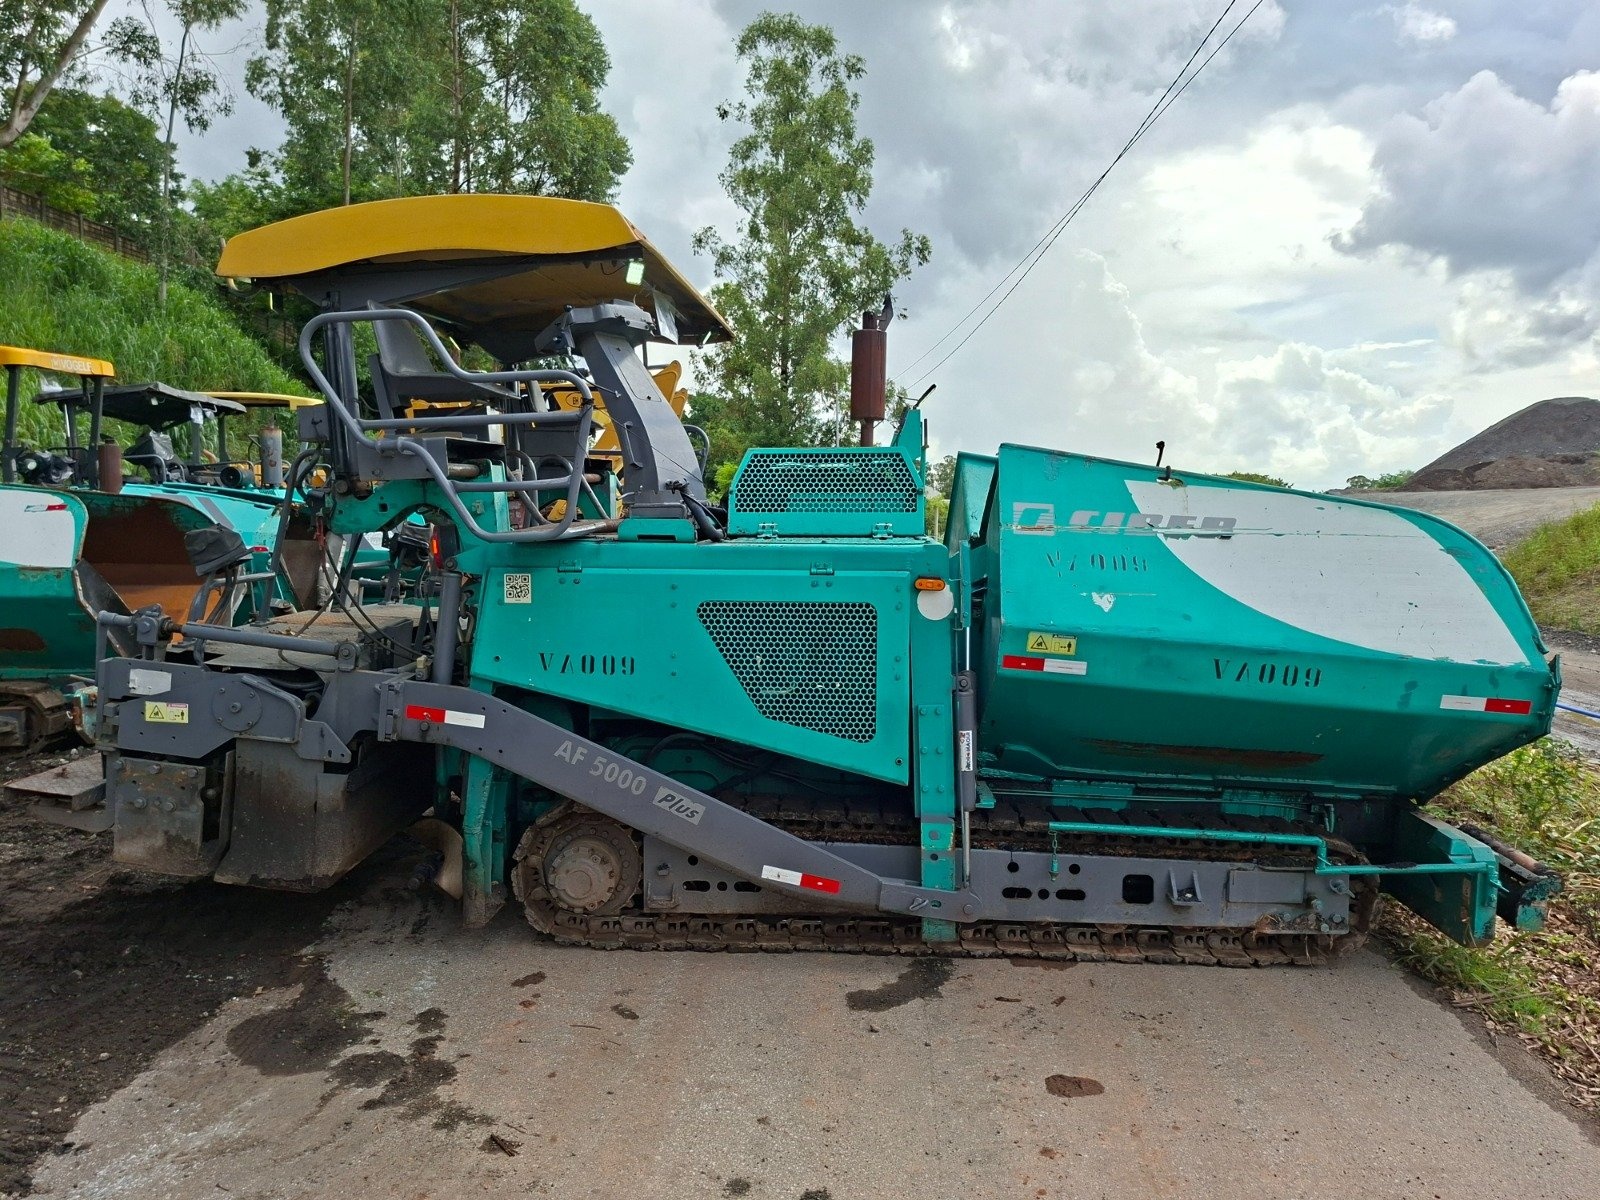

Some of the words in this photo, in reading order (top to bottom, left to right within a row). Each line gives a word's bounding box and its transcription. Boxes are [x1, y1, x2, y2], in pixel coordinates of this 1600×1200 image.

[538, 652, 635, 676] VA009
[1213, 658, 1322, 688] VA009
[554, 740, 588, 765] AF
[589, 756, 647, 796] 5000
[658, 793, 700, 819] Plus
